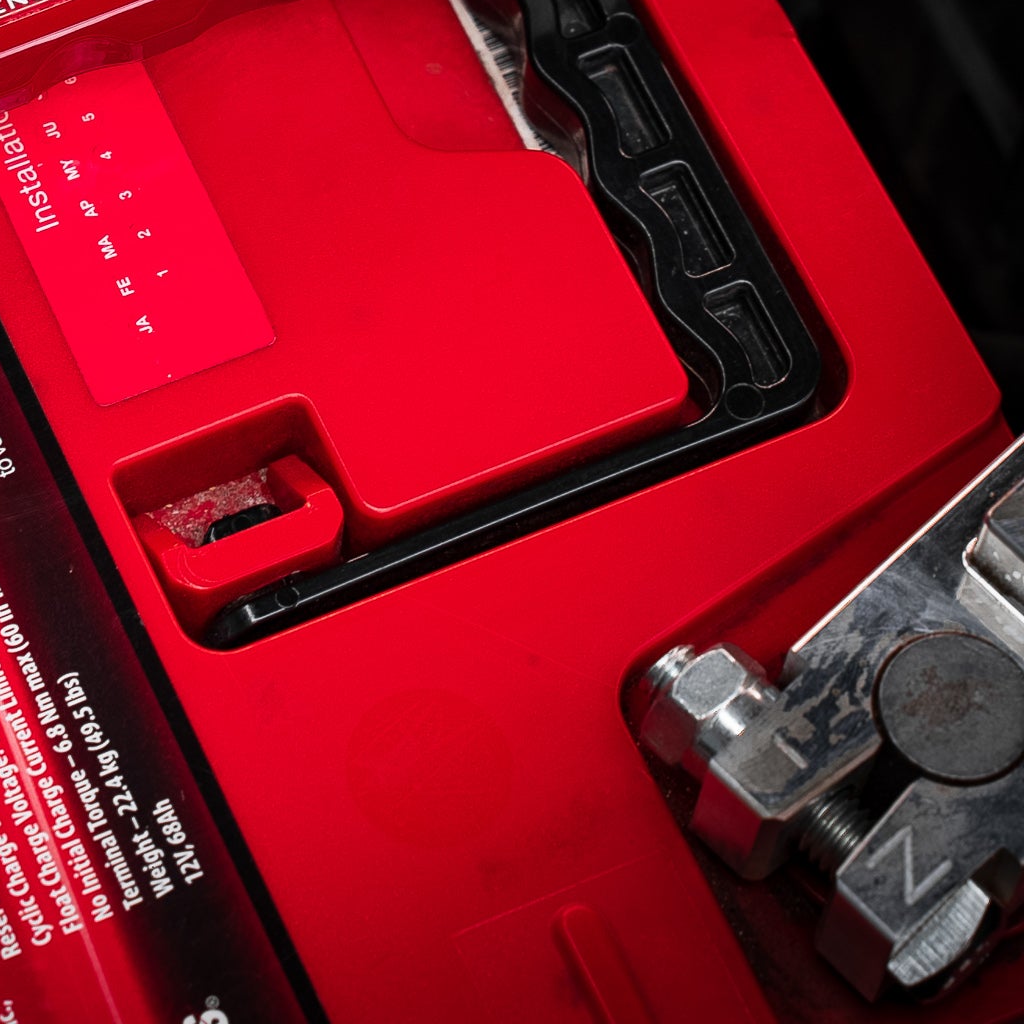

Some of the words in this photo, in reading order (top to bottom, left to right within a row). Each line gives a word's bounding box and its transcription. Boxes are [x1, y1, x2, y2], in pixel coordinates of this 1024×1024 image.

[42, 120, 61, 140] JU
[81, 111, 95, 122] 5
[59, 157, 81, 181] MY
[99, 150, 113, 161] 4
[79, 199, 98, 218] AP
[118, 189, 132, 201] 3
[97, 234, 117, 260] MA
[137, 228, 151, 239] 2
[115, 276, 134, 297] FE
[156, 269, 169, 277] 1
[134, 314, 153, 335] JA
[16, 651, 46, 692] max
[56, 670, 88, 707] lbs)
[32, 691, 60, 725] Nm
[2, 708, 49, 778] Current
[45, 722, 73, 754] 6.8
[72, 704, 111, 752] (49.5
[94, 748, 121, 777] kg
[30, 774, 79, 839] Charge
[67, 767, 111, 833] Torque
[104, 774, 138, 817] 22.4
[151, 798, 187, 846] 68Ah
[16, 819, 68, 888] Charge
[60, 838, 102, 895] Initial
[92, 829, 144, 911] Terminal
[130, 828, 177, 899] Weight
[171, 843, 205, 882] 12V,
[15, 894, 56, 947] Cyclic
[44, 883, 84, 935] Float
[88, 893, 114, 923] No
